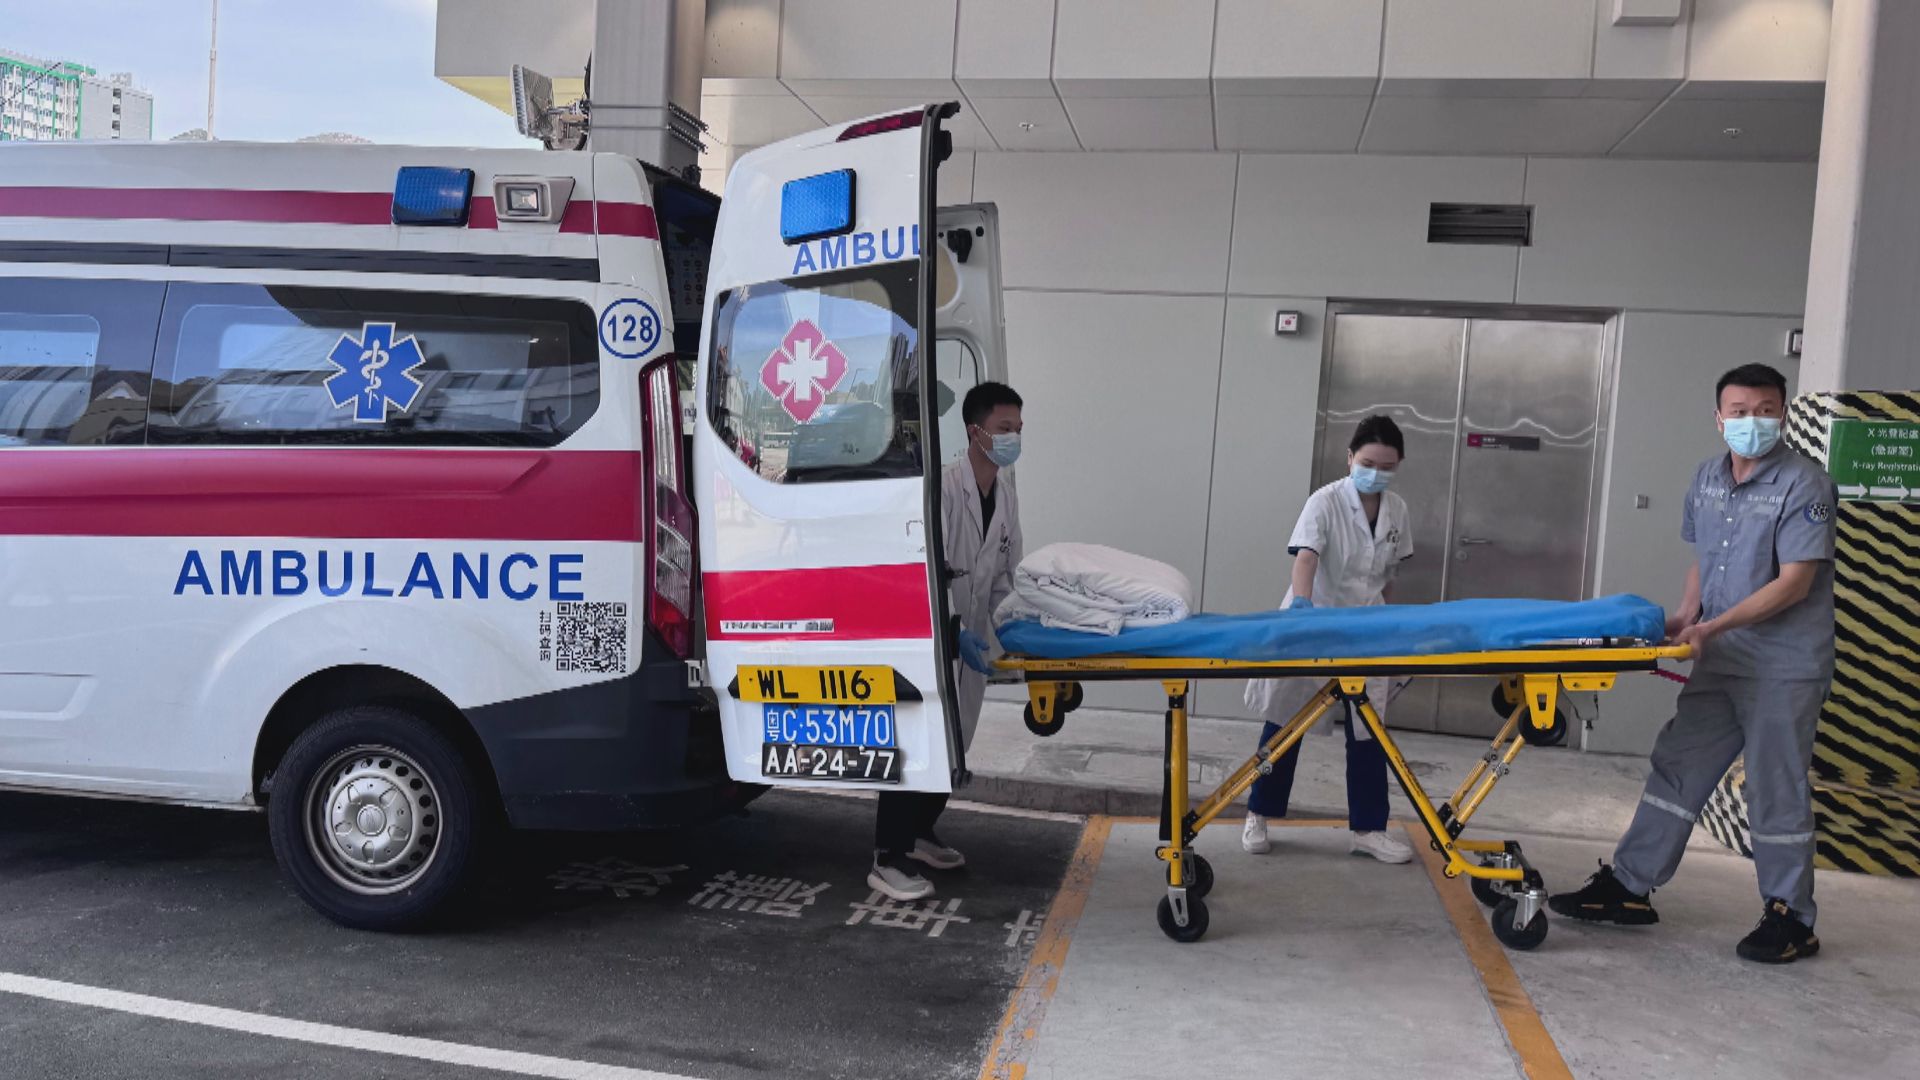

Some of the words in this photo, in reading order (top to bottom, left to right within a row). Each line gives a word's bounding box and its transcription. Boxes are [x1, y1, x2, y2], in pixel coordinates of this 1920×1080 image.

[607, 314, 654, 343] 128
[1852, 460, 1876, 471] X-ray
[173, 549, 584, 601] AMBULANCE
[539, 609, 551, 662] 扫码查询
[724, 621, 797, 630] TRANSIT
[757, 670, 799, 699] WL
[819, 670, 871, 701] 1116
[765, 748, 895, 778] AA-24-77
